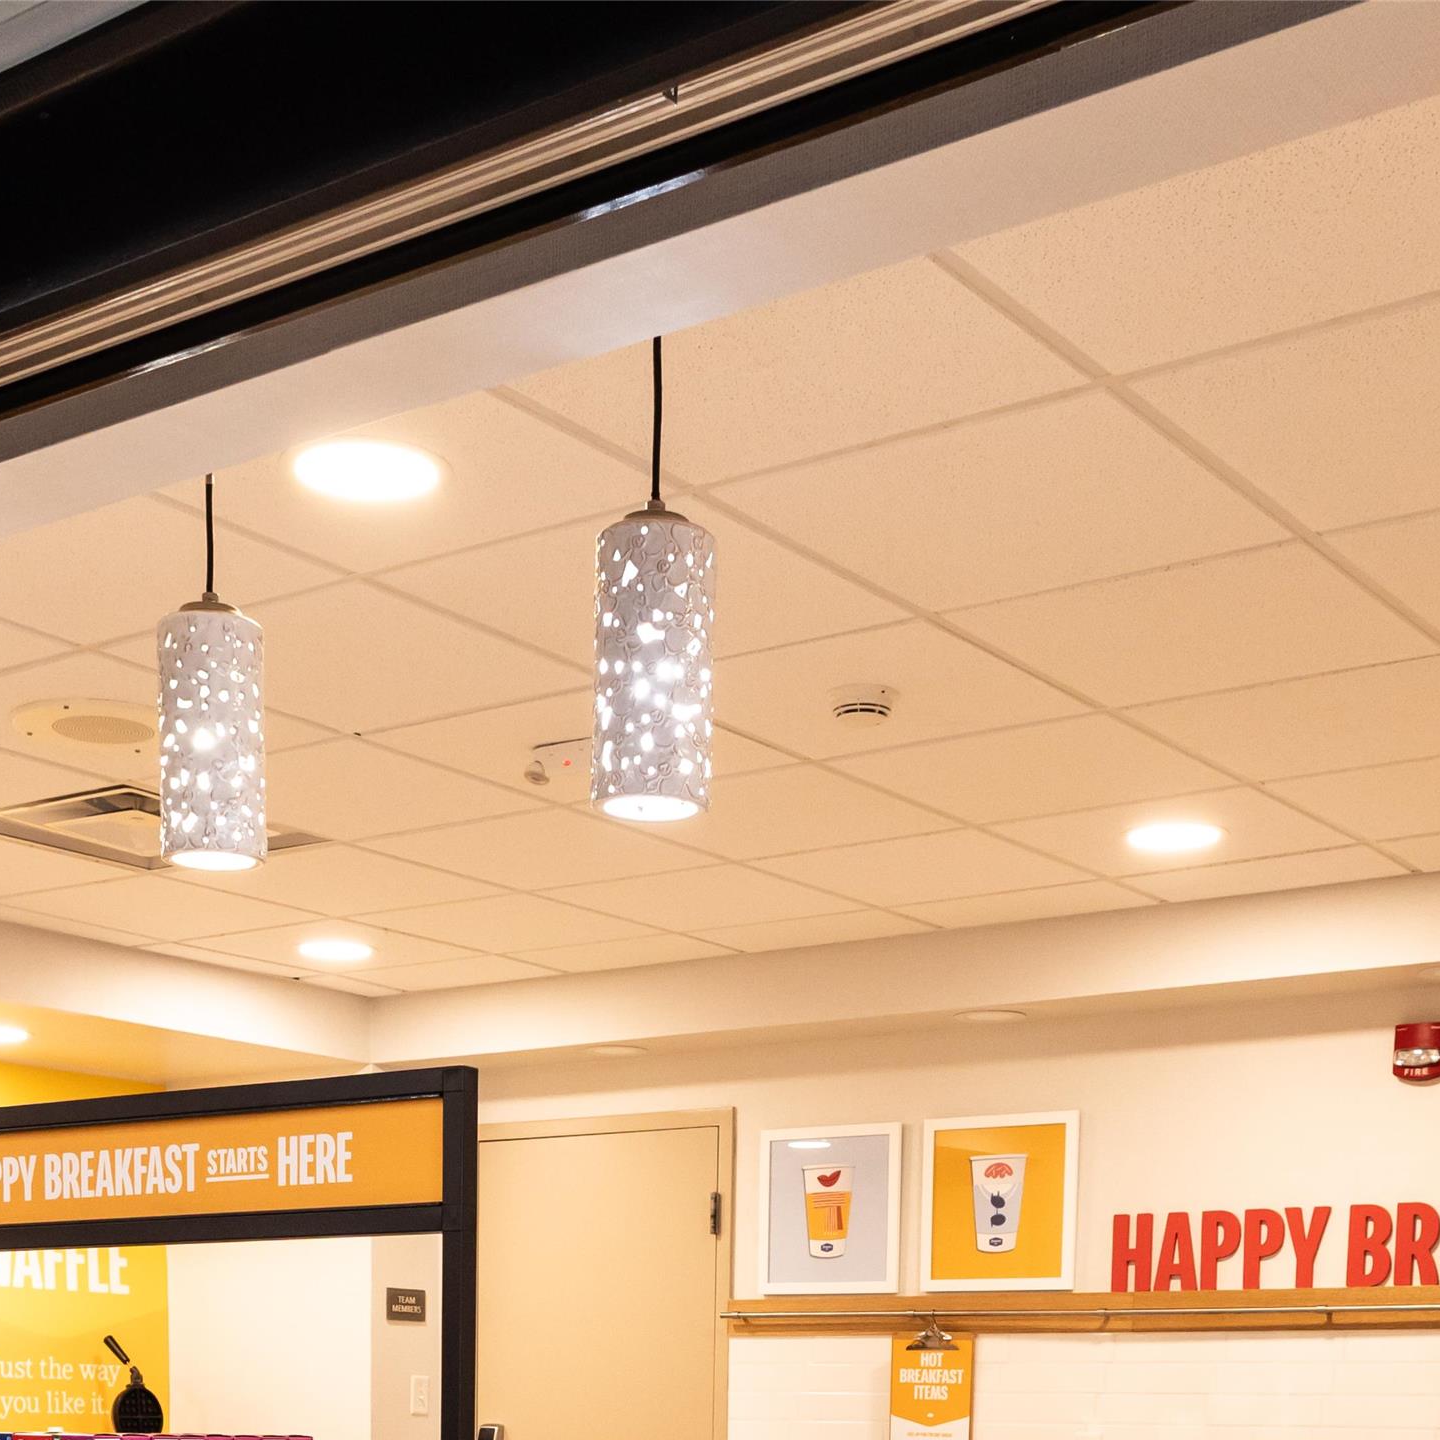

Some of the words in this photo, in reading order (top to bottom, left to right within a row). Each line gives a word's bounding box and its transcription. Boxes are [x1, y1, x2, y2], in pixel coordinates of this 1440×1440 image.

[1403, 1067, 1429, 1077] FIRE
[44, 1143, 200, 1200] BREAKFAST
[206, 1145, 269, 1175] STARTS
[277, 1132, 354, 1187] HERE
[1111, 1205, 1332, 1293] HAPPY
[397, 1295, 417, 1304] TEAM
[392, 1304, 422, 1314] MEMBERS
[920, 1352, 944, 1367] HOT
[39, 1356, 74, 1381] the
[79, 1363, 120, 1388] way
[899, 1368, 965, 1385] BREAKFAST
[913, 1385, 949, 1401] ITEMS
[0, 1394, 40, 1420] you
[47, 1391, 85, 1415] like
[92, 1392, 110, 1415] it.
